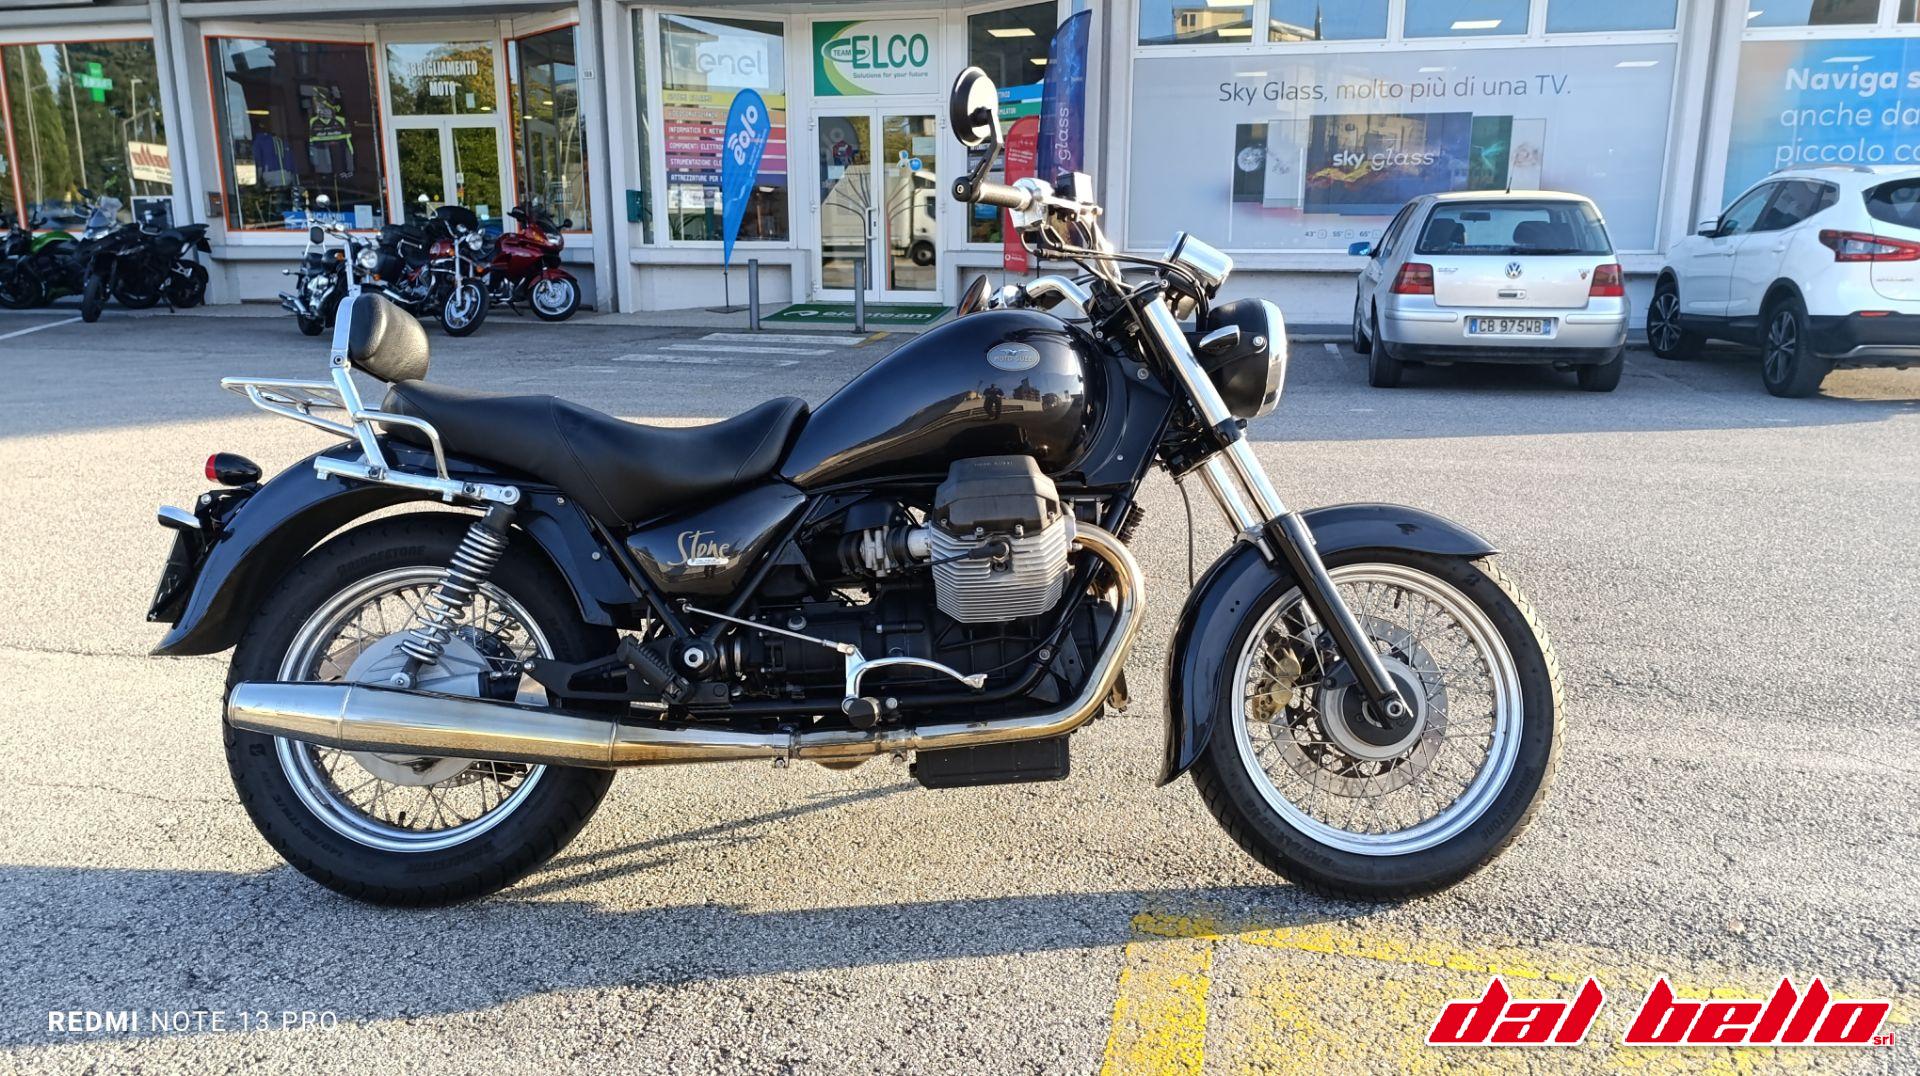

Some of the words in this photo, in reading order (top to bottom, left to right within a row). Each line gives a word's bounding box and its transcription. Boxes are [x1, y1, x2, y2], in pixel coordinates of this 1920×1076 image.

[698, 50, 763, 76] enel
[833, 49, 851, 57] TEAM
[852, 33, 929, 69] ELCO
[429, 81, 456, 96] MOTO
[893, 72, 907, 80] your
[1785, 64, 1899, 97] Naviga
[1218, 82, 1257, 106] Sky
[1263, 81, 1328, 103] Glass,
[1336, 78, 1404, 100] molto
[1410, 76, 1447, 103] più
[1453, 76, 1474, 97] di
[1482, 79, 1527, 96] una
[1535, 74, 1572, 95] TV.
[1780, 101, 1872, 127] anche
[669, 142, 699, 151] COMPONENTI
[728, 104, 758, 166] eolo
[1055, 107, 1071, 160] glass
[670, 158, 711, 166] STRUMENTAZIONE
[1332, 150, 1365, 170] sky
[1371, 148, 1434, 171] glass
[1775, 137, 1885, 169] piccolo
[671, 174, 707, 182] ATTREZZATURE
[1479, 320, 1495, 333] CB
[1500, 320, 1542, 333] 975WB
[666, 530, 731, 566] Stone
